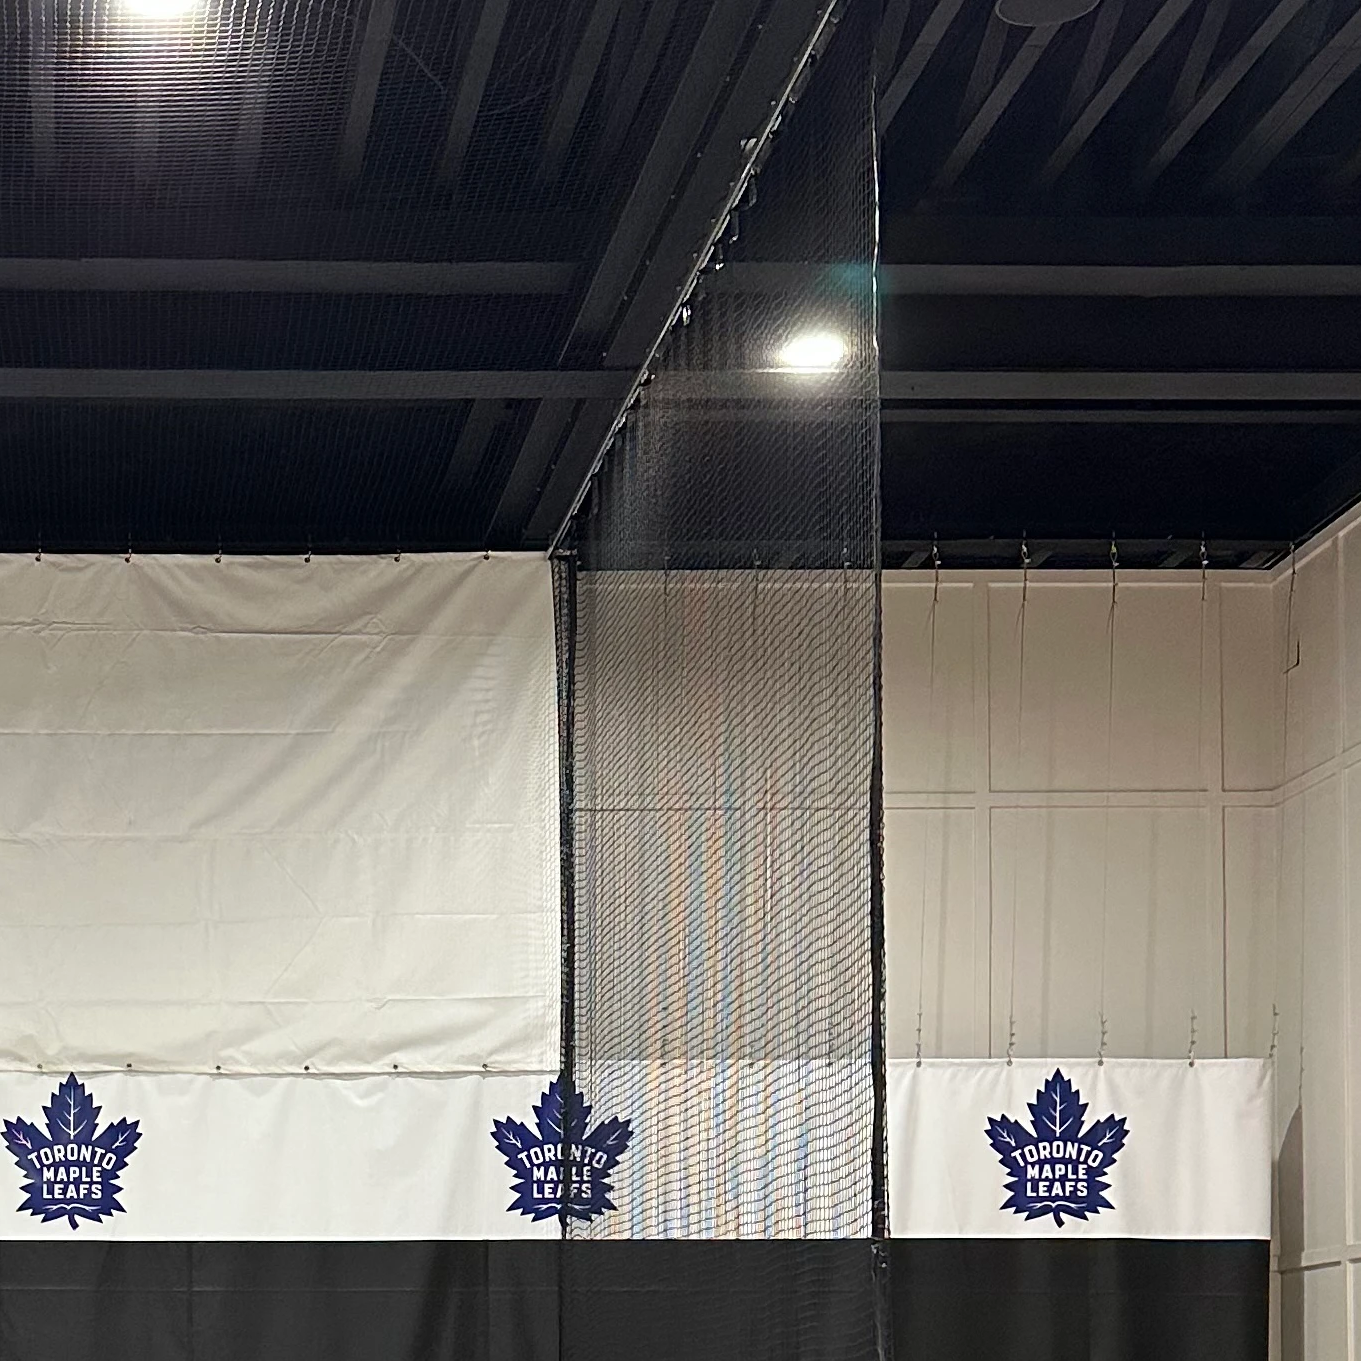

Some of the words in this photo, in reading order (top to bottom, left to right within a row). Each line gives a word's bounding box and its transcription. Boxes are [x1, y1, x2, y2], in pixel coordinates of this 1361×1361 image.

[27, 1143, 117, 1170] TORONTO
[1011, 1141, 1104, 1168] TORONTO
[42, 1166, 102, 1182] MAPLE
[1026, 1164, 1088, 1179] MAPLE
[42, 1184, 102, 1199] LEAFS
[1026, 1181, 1088, 1197] LEAFS
